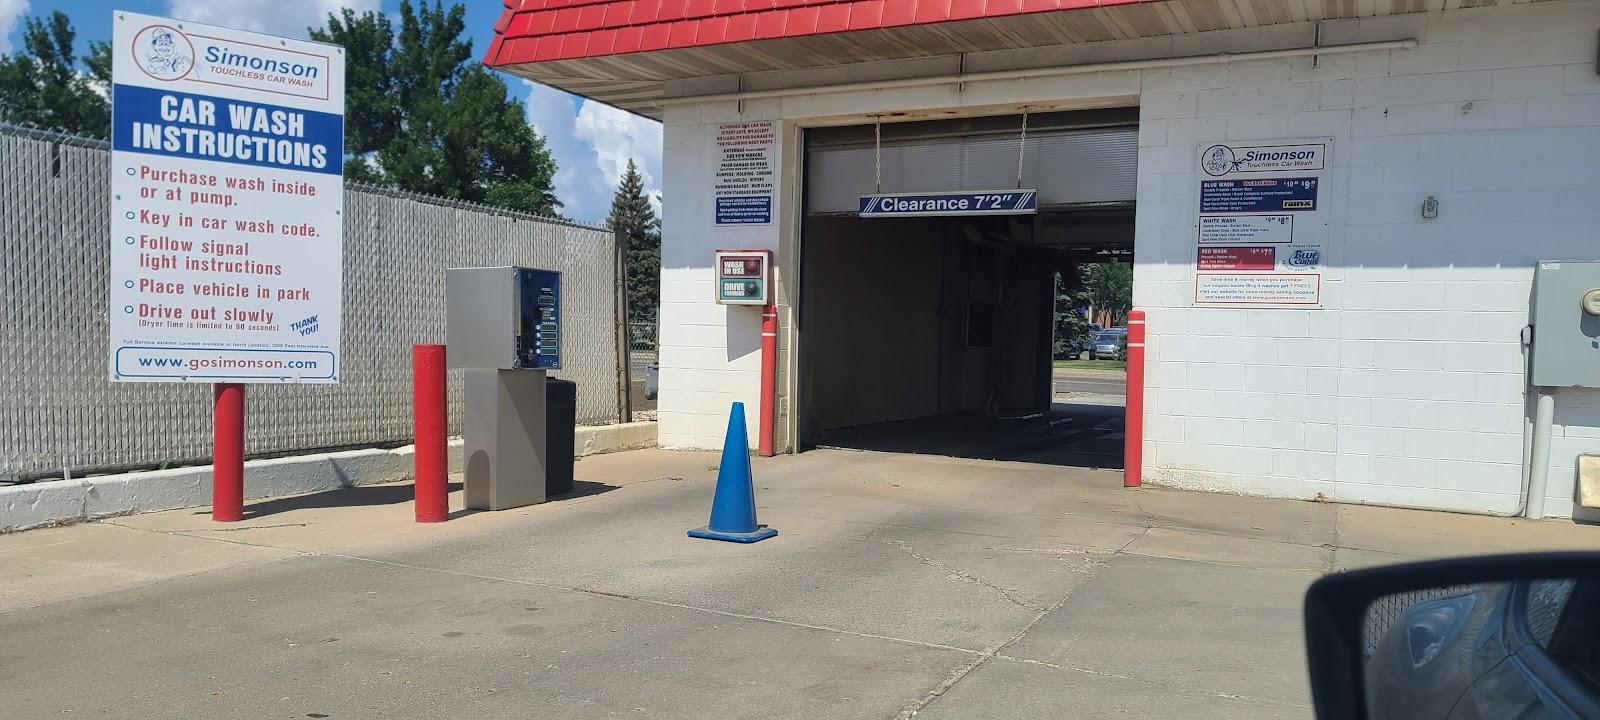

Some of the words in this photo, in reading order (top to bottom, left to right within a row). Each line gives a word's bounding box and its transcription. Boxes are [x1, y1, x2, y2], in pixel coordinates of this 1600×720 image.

[205, 46, 318, 78] Simonson
[210, 65, 264, 80] TOUCHLESS
[267, 73, 286, 84] CAR
[287, 76, 313, 88] WASH
[161, 95, 215, 126] CAR
[229, 104, 304, 138] WASH
[132, 122, 326, 169] INSTRUCTIONS
[1246, 151, 1315, 161] Simonson
[141, 166, 216, 187] Purchase
[226, 177, 264, 191] wash
[272, 179, 316, 196] inside
[141, 188, 156, 199] or
[166, 188, 182, 201] at
[191, 192, 238, 207] pump.
[881, 198, 968, 212] Clearance
[140, 210, 170, 227] Key
[179, 212, 193, 227] in
[201, 217, 227, 230] car
[236, 219, 274, 234] wash
[282, 223, 320, 237] code.
[140, 235, 193, 251] Follow
[202, 239, 248, 257] signal
[140, 254, 177, 271] light
[185, 256, 282, 275] instructions
[140, 279, 184, 295] Place
[193, 282, 249, 298] vehicle
[257, 285, 270, 299] in
[278, 288, 309, 301] park
[139, 304, 182, 319] Drive
[191, 306, 216, 320] out
[224, 308, 273, 324] slowly
[139, 319, 163, 328] (Dryer
[290, 315, 318, 331] THANK
[300, 324, 319, 336] YOU!
[139, 356, 317, 370] www.gosimonson.com
